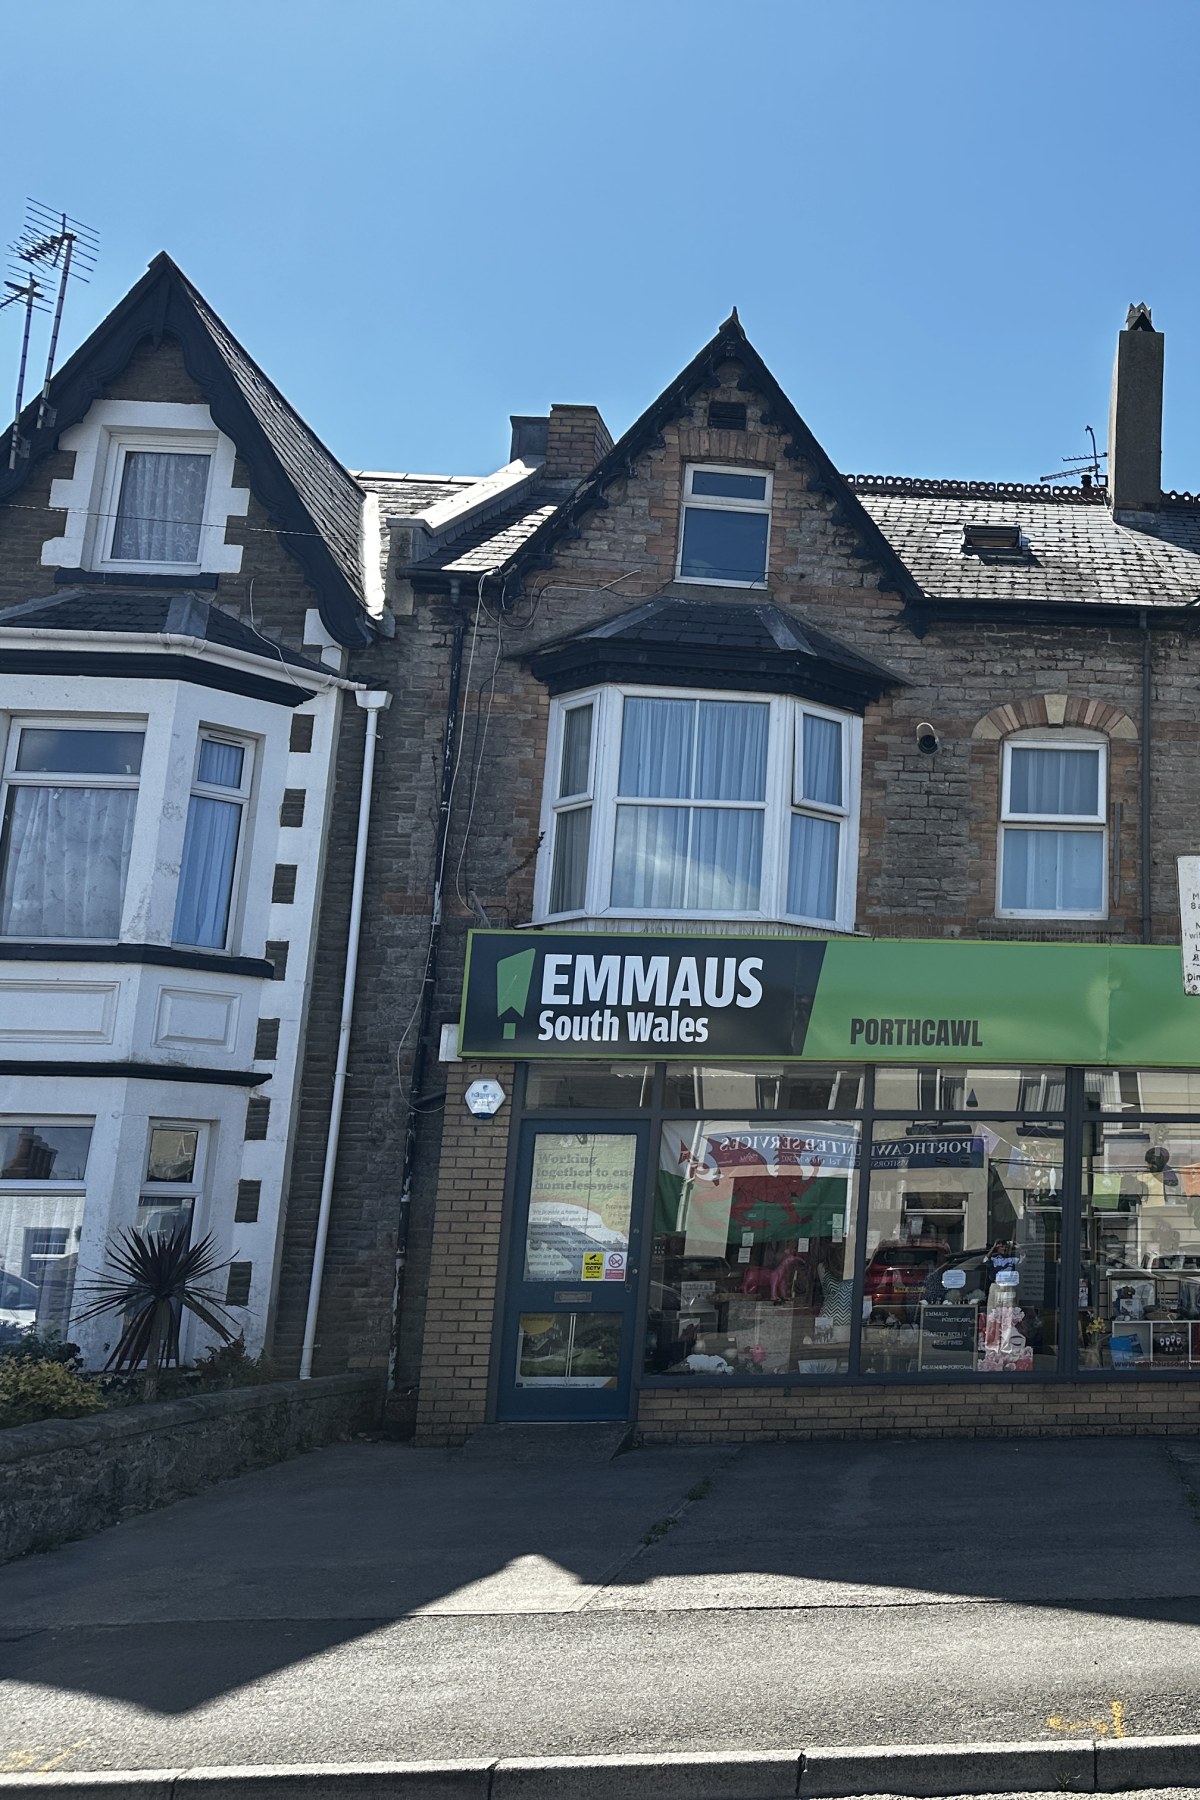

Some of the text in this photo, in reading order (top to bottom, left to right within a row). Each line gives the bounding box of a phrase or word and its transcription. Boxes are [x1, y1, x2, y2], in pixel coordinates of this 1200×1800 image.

[540, 953, 764, 1009] EMMAUS
[538, 1009, 709, 1043] South Wales
[850, 1018, 983, 1047] PORTHCAWL
[537, 1153, 598, 1167] Working
[596, 1167, 609, 1178] to
[534, 1180, 629, 1191] homelessness
